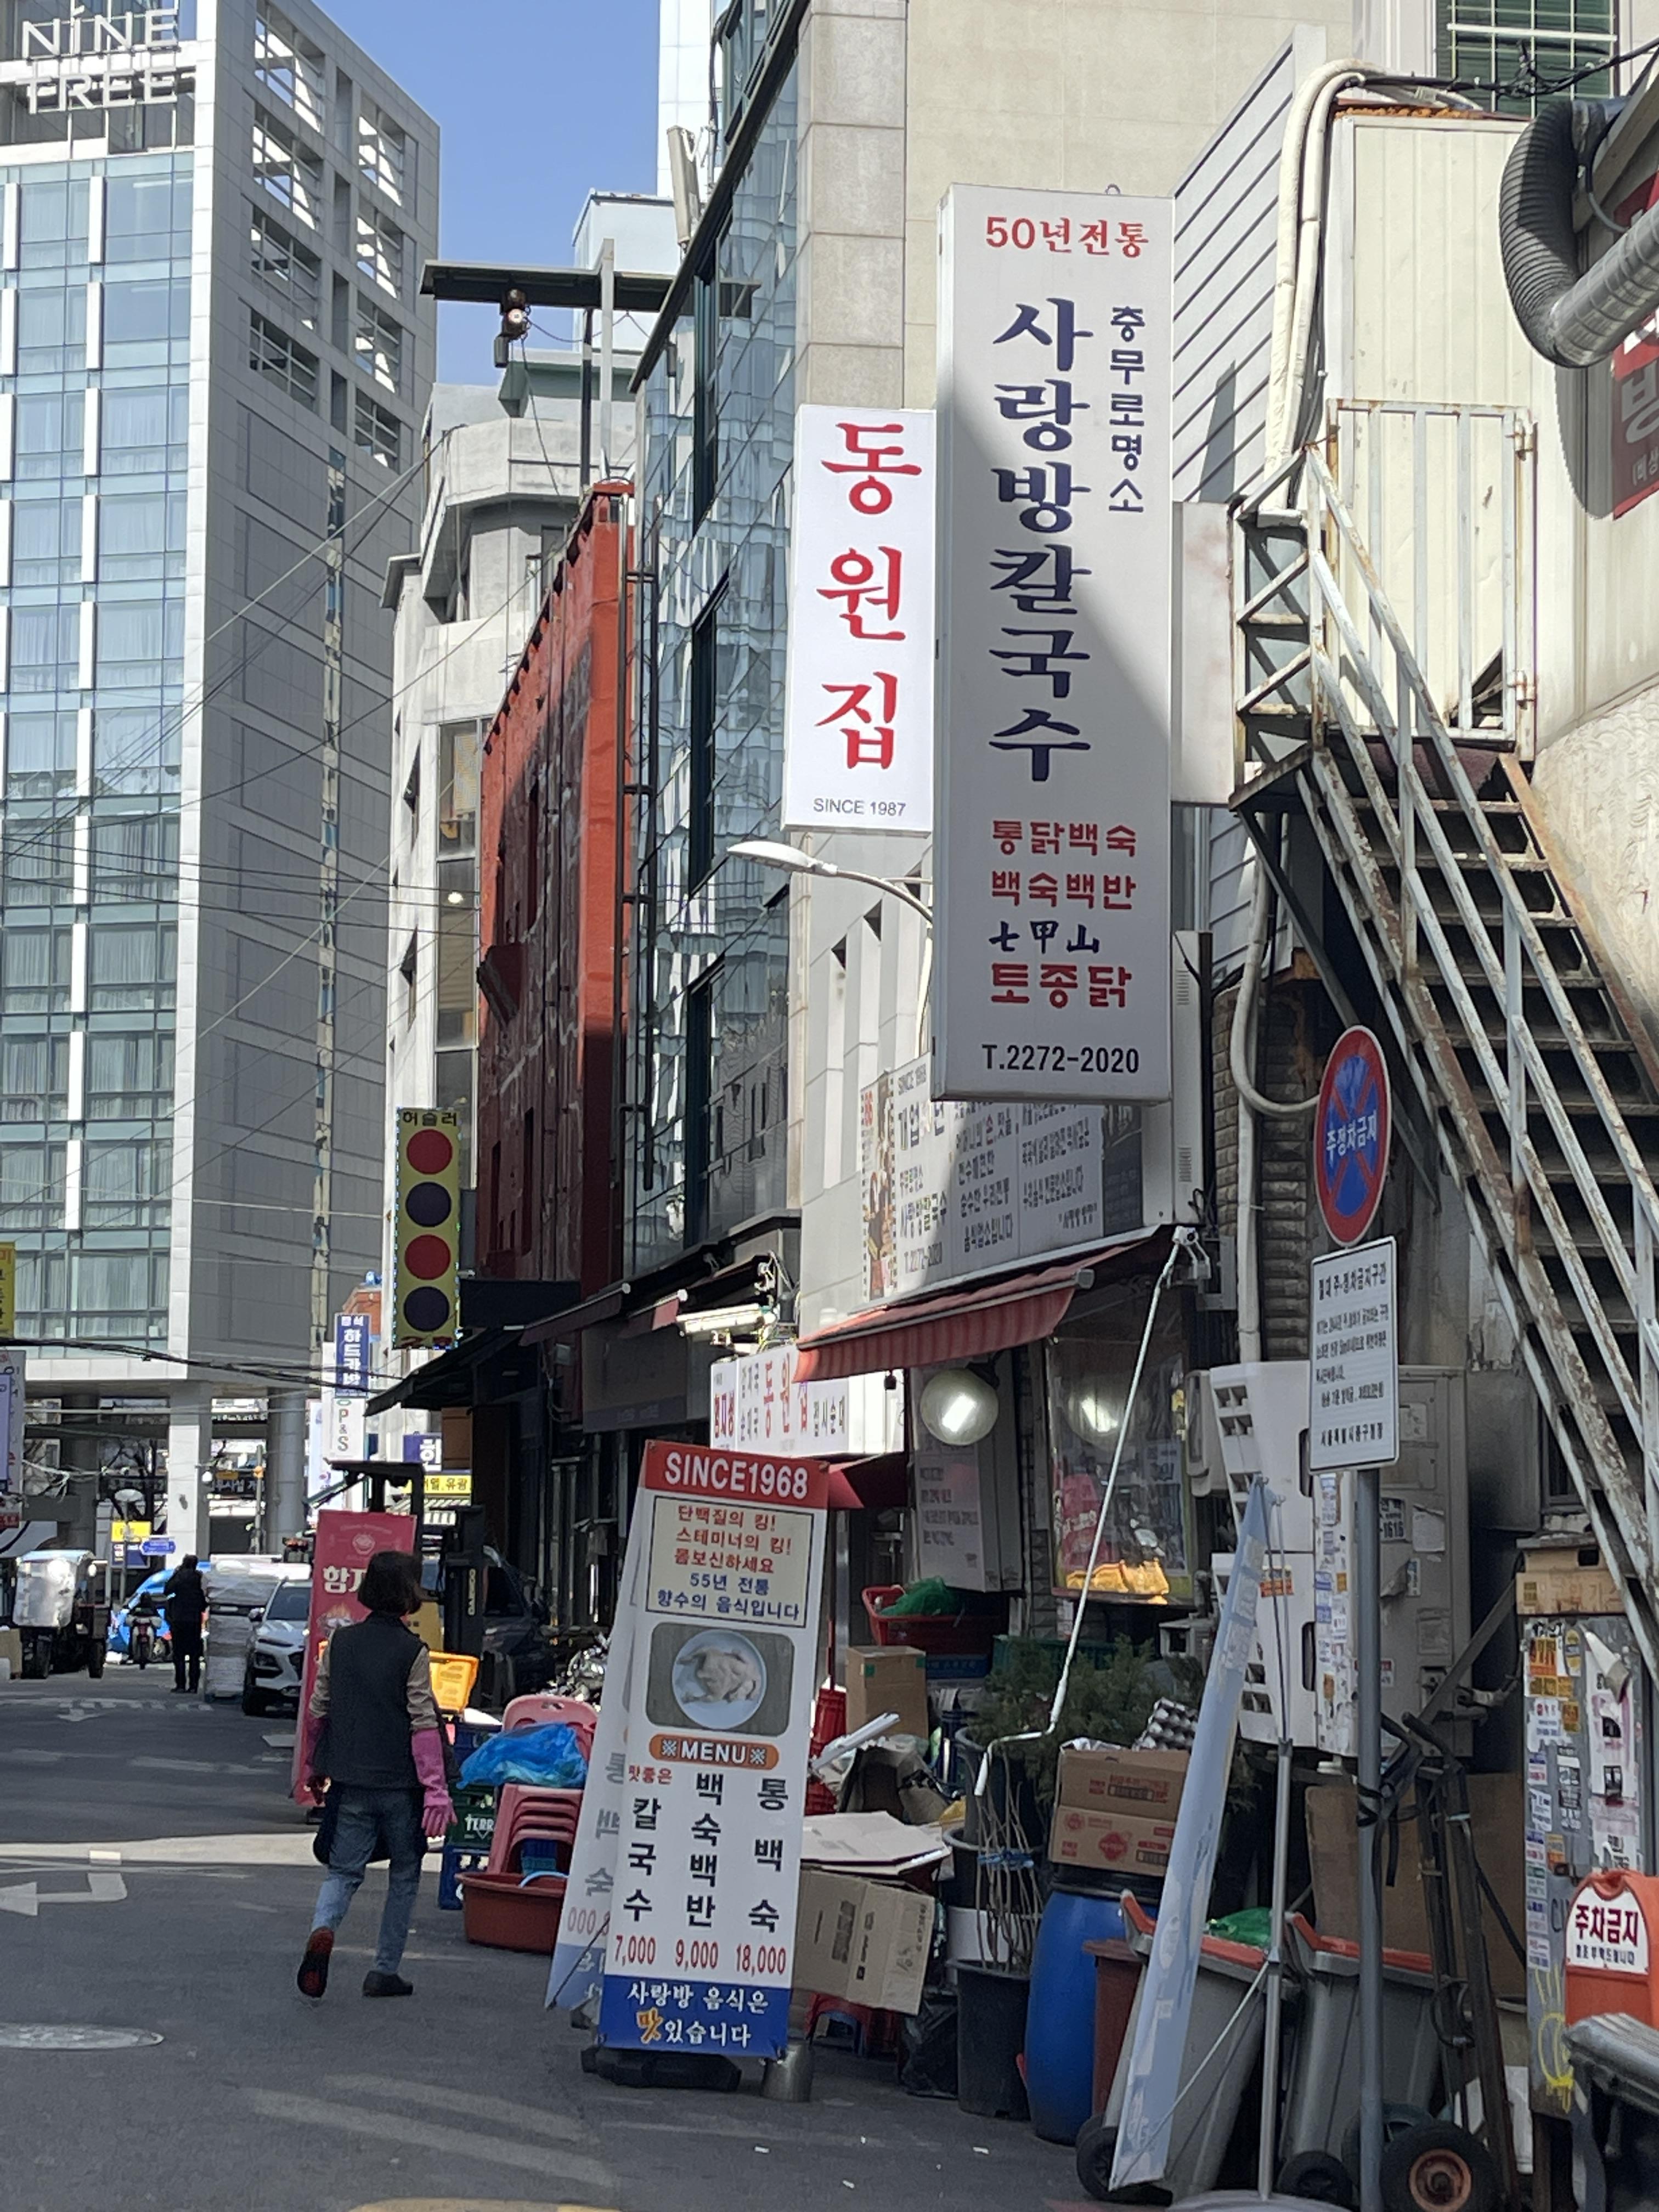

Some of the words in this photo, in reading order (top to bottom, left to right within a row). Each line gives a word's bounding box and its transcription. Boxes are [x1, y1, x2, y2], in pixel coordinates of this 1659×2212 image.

[15, 66, 177, 114] TREE
[986, 217, 1149, 257] 50년전통
[1108, 306, 1146, 513] 충무로명소
[989, 298, 1094, 782] 사랑방칼국수
[814, 422, 922, 769] 동원집
[813, 798, 865, 815] SINCE
[870, 801, 906, 817] 1987
[992, 820, 1136, 857] 통닭백숙
[991, 870, 1137, 910] 백숙백반
[989, 921, 1100, 953] 七甲山
[991, 963, 1132, 1008] 토종닭
[982, 1045, 1139, 1074] T.2272-2020
[1326, 1109, 1377, 1167] 주정차금지
[665, 1452, 808, 1499] SINCE1968
[676, 1526, 760, 1551] 스테미너의
[690, 1572, 727, 1592] 55년
[738, 1576, 769, 1596] 전통
[716, 1595, 799, 1621] 음식입니다
[464, 1813, 494, 1831] TERR
[623, 1797, 662, 1922] 칼국수
[686, 1773, 725, 1928] 백숙백반
[748, 1778, 789, 1933] 통백숙
[1576, 1905, 1638, 1948] 주차금지
[615, 1935, 656, 1967] 7,000
[675, 1939, 719, 1971] 9,000
[737, 1944, 786, 1977] 18,000
[628, 1980, 695, 2009] 사랑방
[703, 1986, 769, 2015] 음식은
[636, 2006, 752, 2049] 맛있습니다
